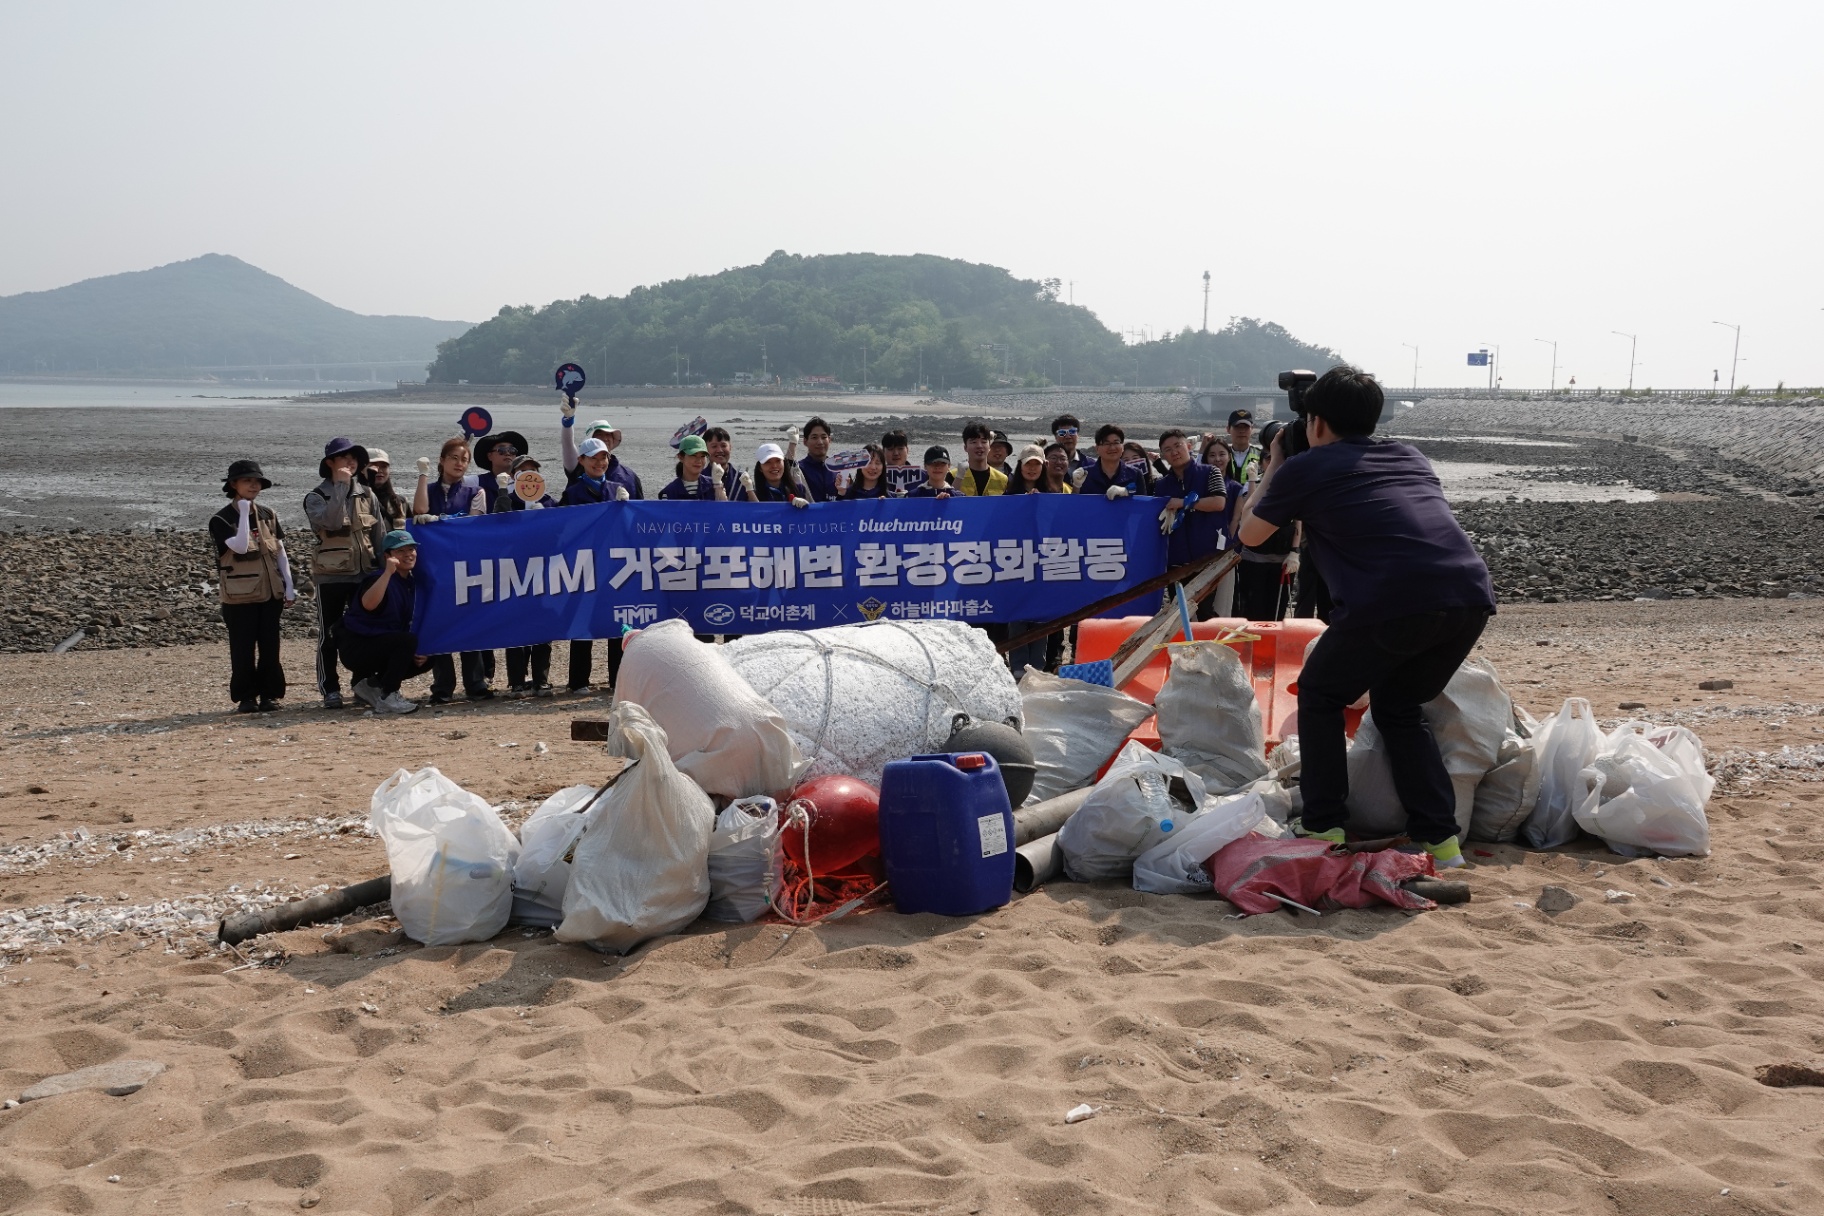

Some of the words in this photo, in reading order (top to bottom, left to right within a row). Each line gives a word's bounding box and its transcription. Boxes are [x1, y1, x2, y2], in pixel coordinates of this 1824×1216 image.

[636, 521, 711, 535] NAVIGATE
[716, 522, 727, 534] A
[731, 522, 783, 534] BLUER
[857, 516, 964, 536] bluehmming
[453, 548, 597, 606] HMM
[608, 545, 844, 591] 거잠포해변
[854, 536, 1128, 588] 환경정화활동
[613, 603, 658, 625] HMM
[739, 603, 816, 622] 덕교어촌계
[890, 599, 994, 619] 하늘바다파출소
